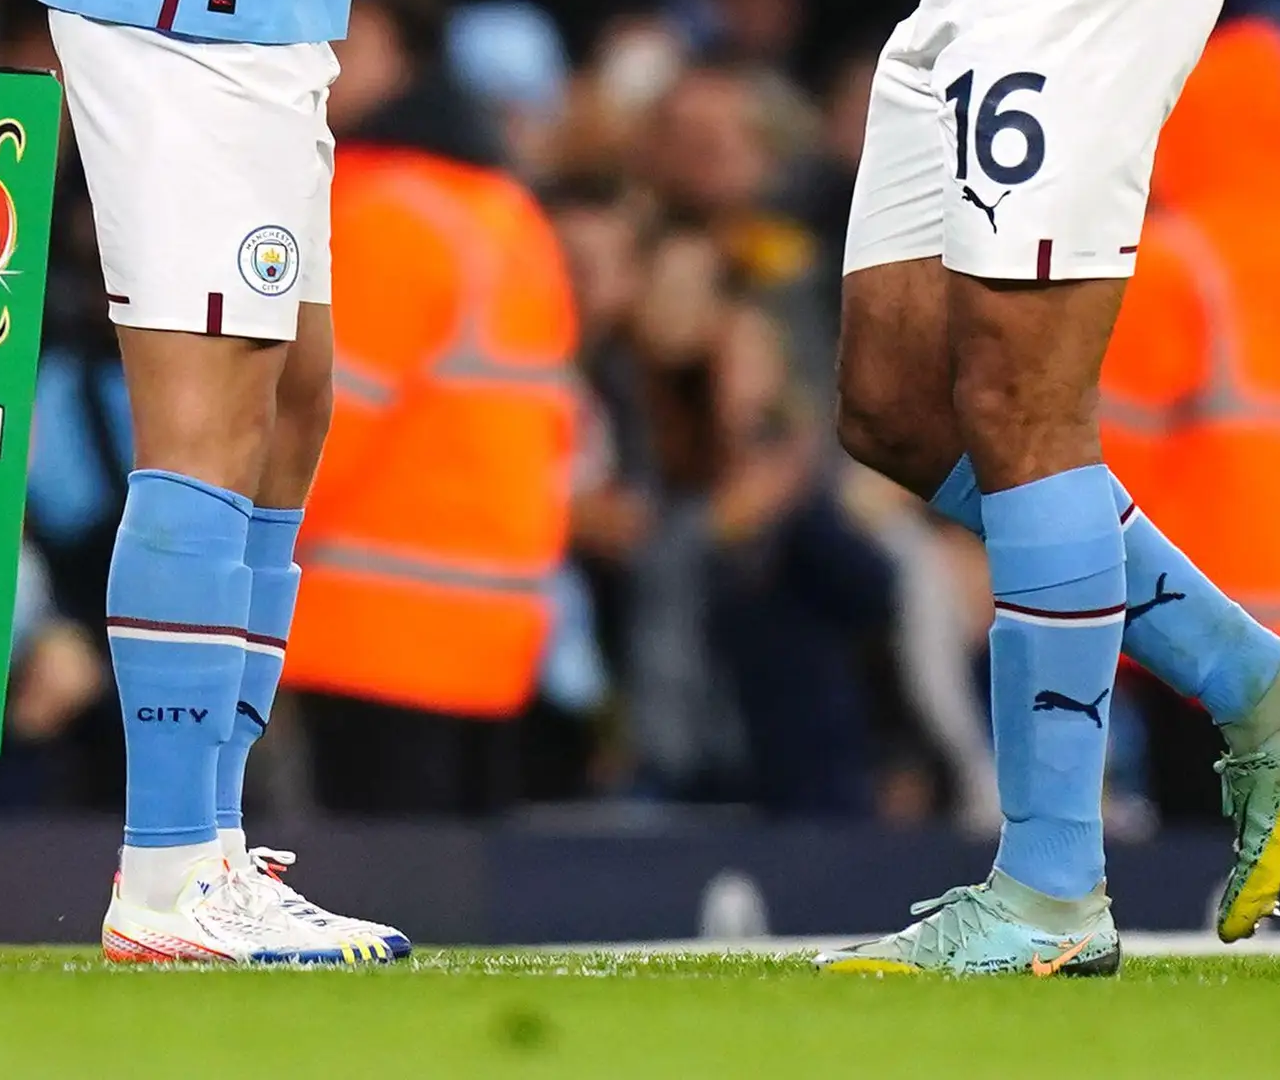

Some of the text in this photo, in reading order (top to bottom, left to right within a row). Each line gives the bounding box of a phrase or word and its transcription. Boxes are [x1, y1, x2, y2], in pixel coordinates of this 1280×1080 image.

[945, 68, 1047, 186] 16
[246, 231, 294, 253] MANCHESTER
[137, 706, 209, 724] CITY
